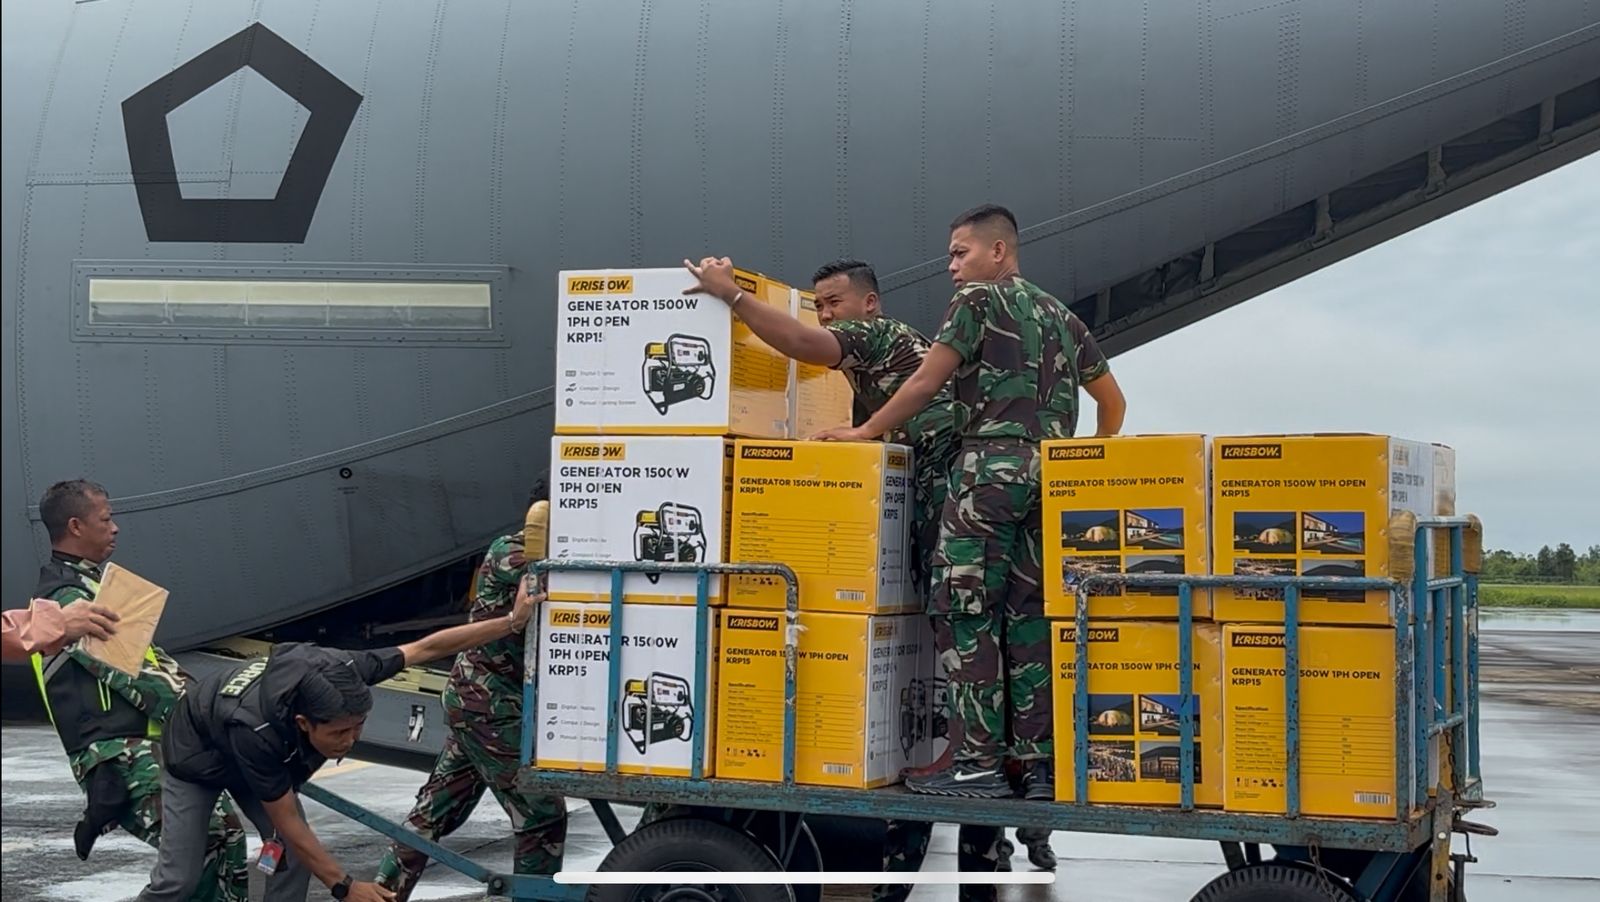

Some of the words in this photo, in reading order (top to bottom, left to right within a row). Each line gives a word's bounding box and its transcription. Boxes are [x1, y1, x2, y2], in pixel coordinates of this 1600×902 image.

[567, 300, 649, 311] GENERATOR
[653, 299, 698, 310] 1500W
[567, 316, 590, 328] 1PH
[594, 316, 630, 327] OPEN
[560, 466, 640, 478] GENERATOR
[645, 467, 690, 478] 1500W
[560, 482, 582, 493] 1PH
[740, 477, 791, 486] GENERATOR
[793, 478, 820, 488] 1500W
[822, 480, 838, 488] 1PH
[840, 481, 862, 489] OPEN
[1049, 479, 1105, 488] GENERATOR
[1107, 478, 1138, 486] 1500W
[1140, 478, 1156, 486] 1PH
[1158, 476, 1184, 485] OPEN
[1222, 480, 1281, 488] GENERATOR
[1284, 480, 1316, 488] 1500W
[1338, 479, 1366, 487] OPEN
[740, 486, 764, 494] KRP15
[1049, 490, 1076, 498] KRP15
[1222, 490, 1250, 498] KRP15
[559, 498, 598, 509] KRP15
[550, 632, 630, 646] GENERATR
[634, 636, 678, 648] 1500W
[549, 649, 571, 660] 1PH
[575, 650, 610, 661] OPEN
[726, 648, 778, 657] GENERATOR
[780, 650, 806, 658] 15W
[810, 652, 824, 660] 1PH
[826, 652, 849, 661] OPEN
[726, 656, 751, 664] KRP15
[549, 664, 587, 676] KRP15
[1060, 662, 1118, 670] GERATOR
[1121, 662, 1152, 670] 1500W
[1156, 662, 1172, 670] 1PH
[1174, 662, 1200, 670] ON
[1232, 668, 1286, 676] GENERATO
[1299, 669, 1329, 678] 500W
[1332, 670, 1350, 678] 1PH
[1352, 671, 1380, 679] OPEN
[1232, 678, 1262, 686] KRP15
